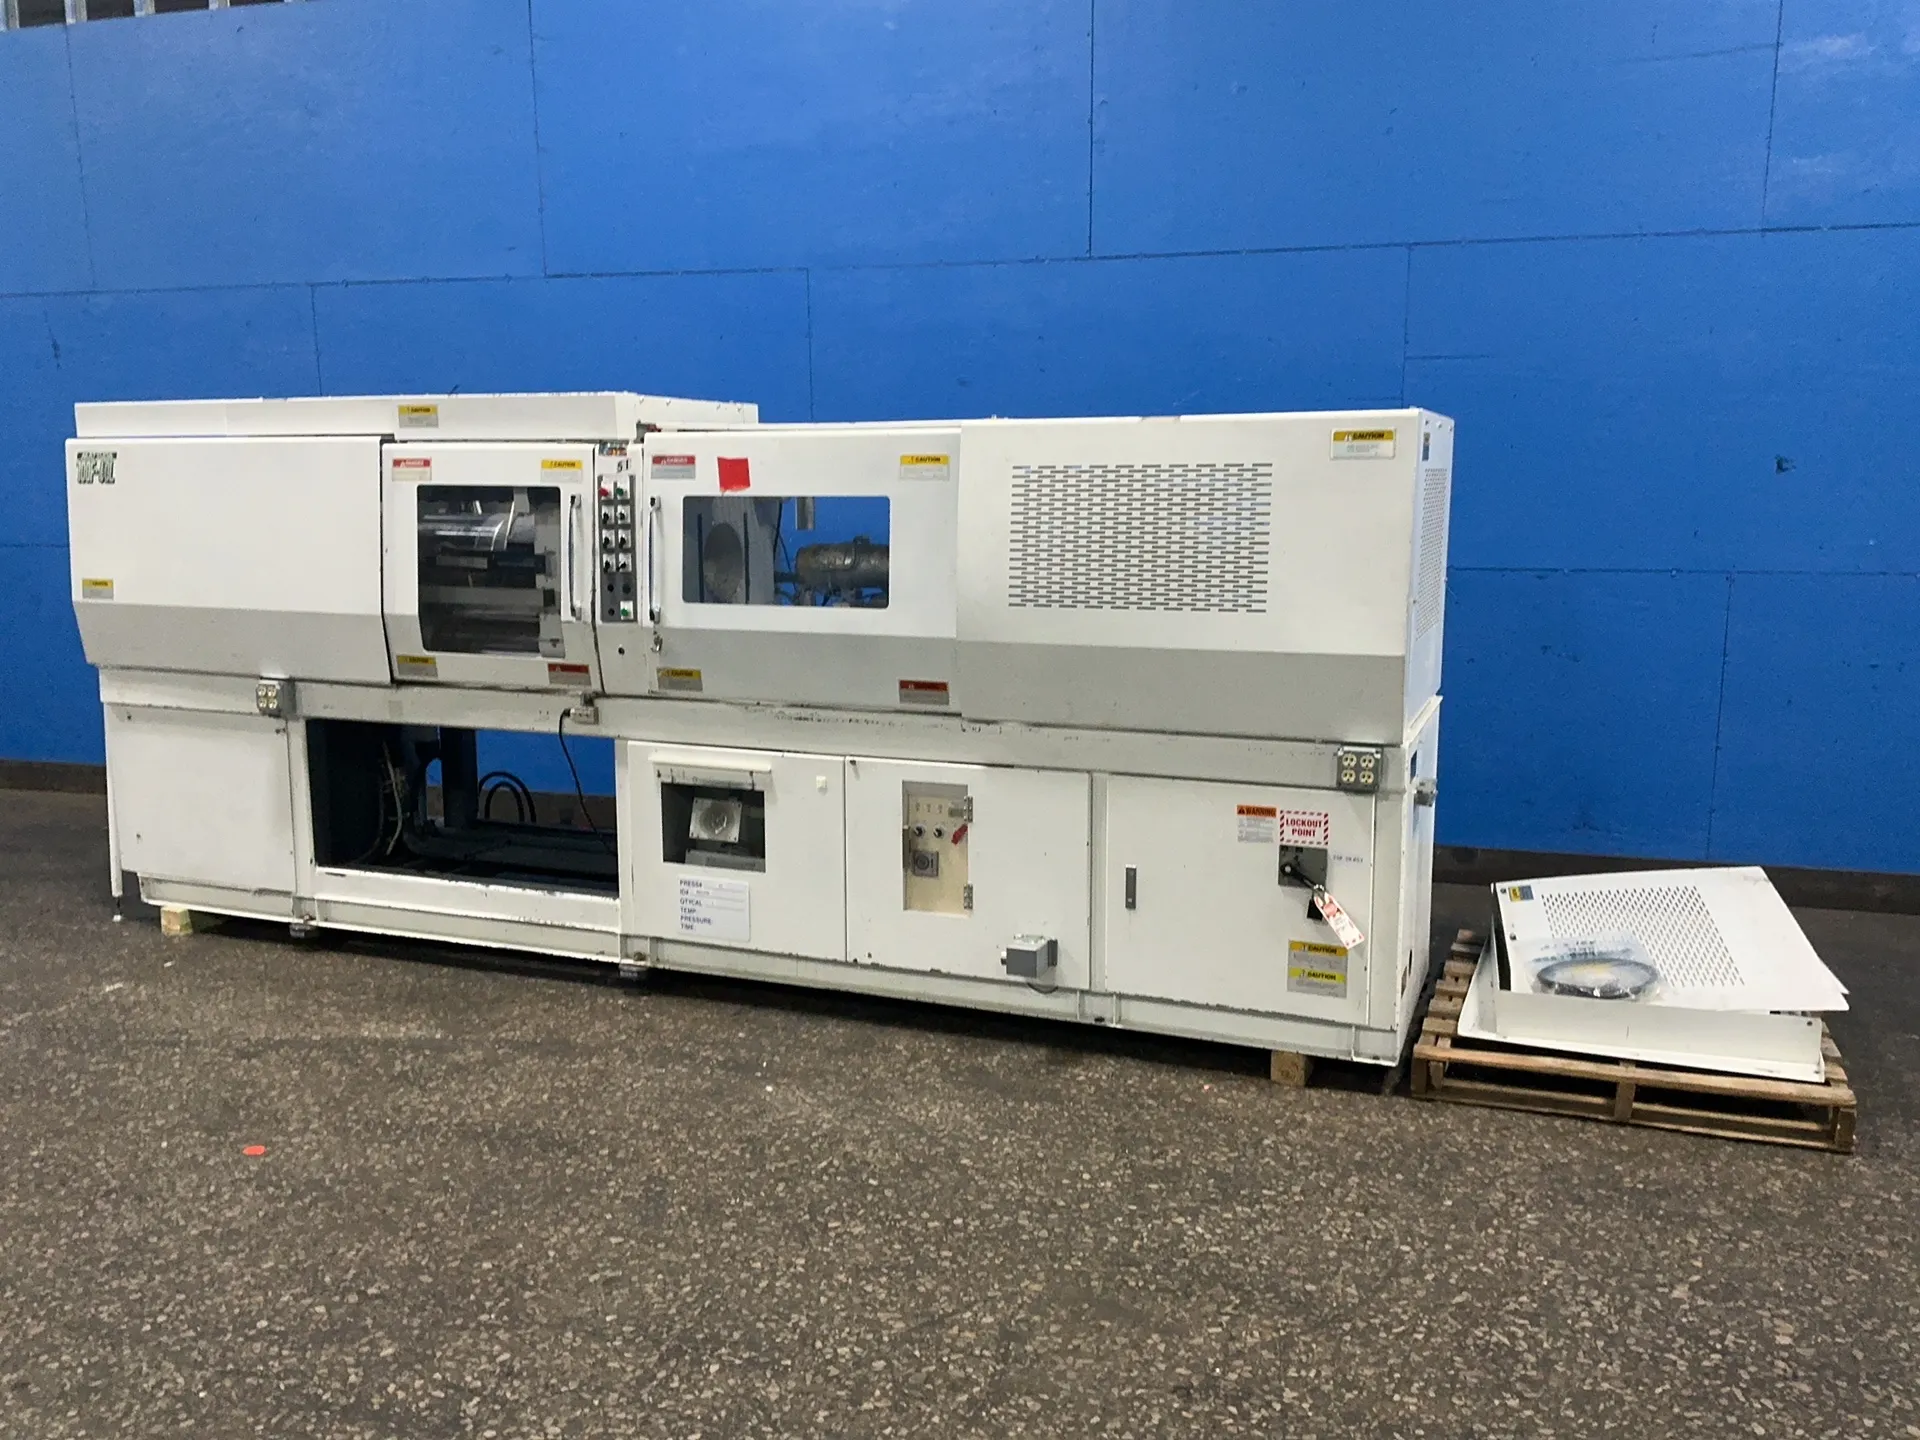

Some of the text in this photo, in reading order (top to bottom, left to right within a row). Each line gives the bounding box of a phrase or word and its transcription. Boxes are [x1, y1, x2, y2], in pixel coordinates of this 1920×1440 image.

[1353, 431, 1385, 440] CAUTION
[1246, 807, 1276, 818] WARNING
[1286, 818, 1323, 828] LOCKOUT
[1292, 828, 1317, 837] POINT
[680, 915, 712, 925] PRESSURE
[1308, 945, 1337, 955] CAUTION
[1308, 972, 1337, 981] CAUTION
